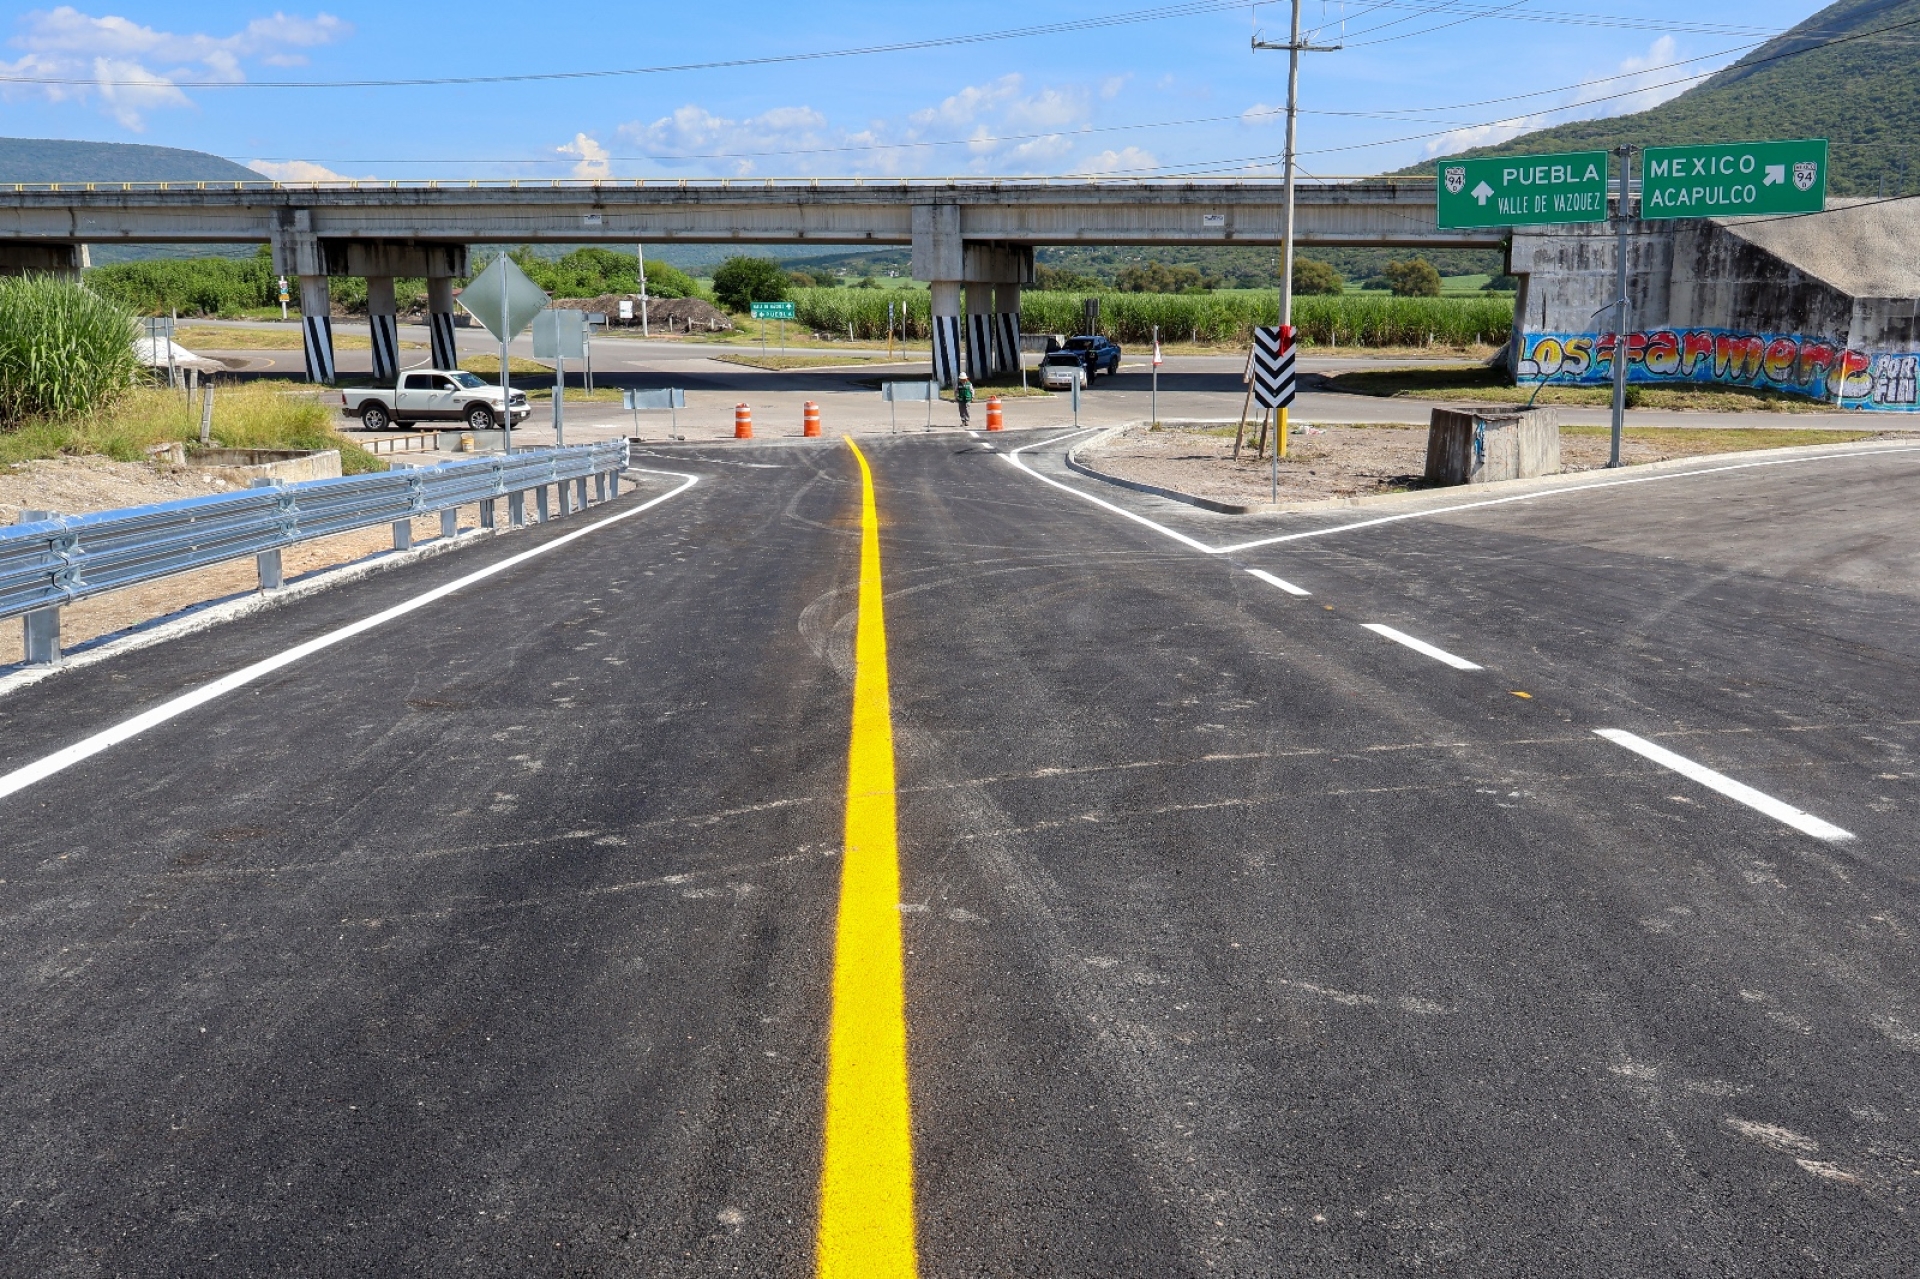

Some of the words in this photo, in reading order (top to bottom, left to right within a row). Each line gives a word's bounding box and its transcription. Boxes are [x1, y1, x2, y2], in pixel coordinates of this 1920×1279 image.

[1503, 163, 1600, 187] PUEBLA
[1650, 155, 1756, 178] MEXICO
[1797, 172, 1812, 182] 94
[1448, 176, 1462, 186] 94
[1498, 195, 1529, 215] VALLE
[1534, 194, 1547, 213] DE
[1553, 192, 1600, 212] VAZQUEZ
[1650, 184, 1756, 207] ACAPULCO
